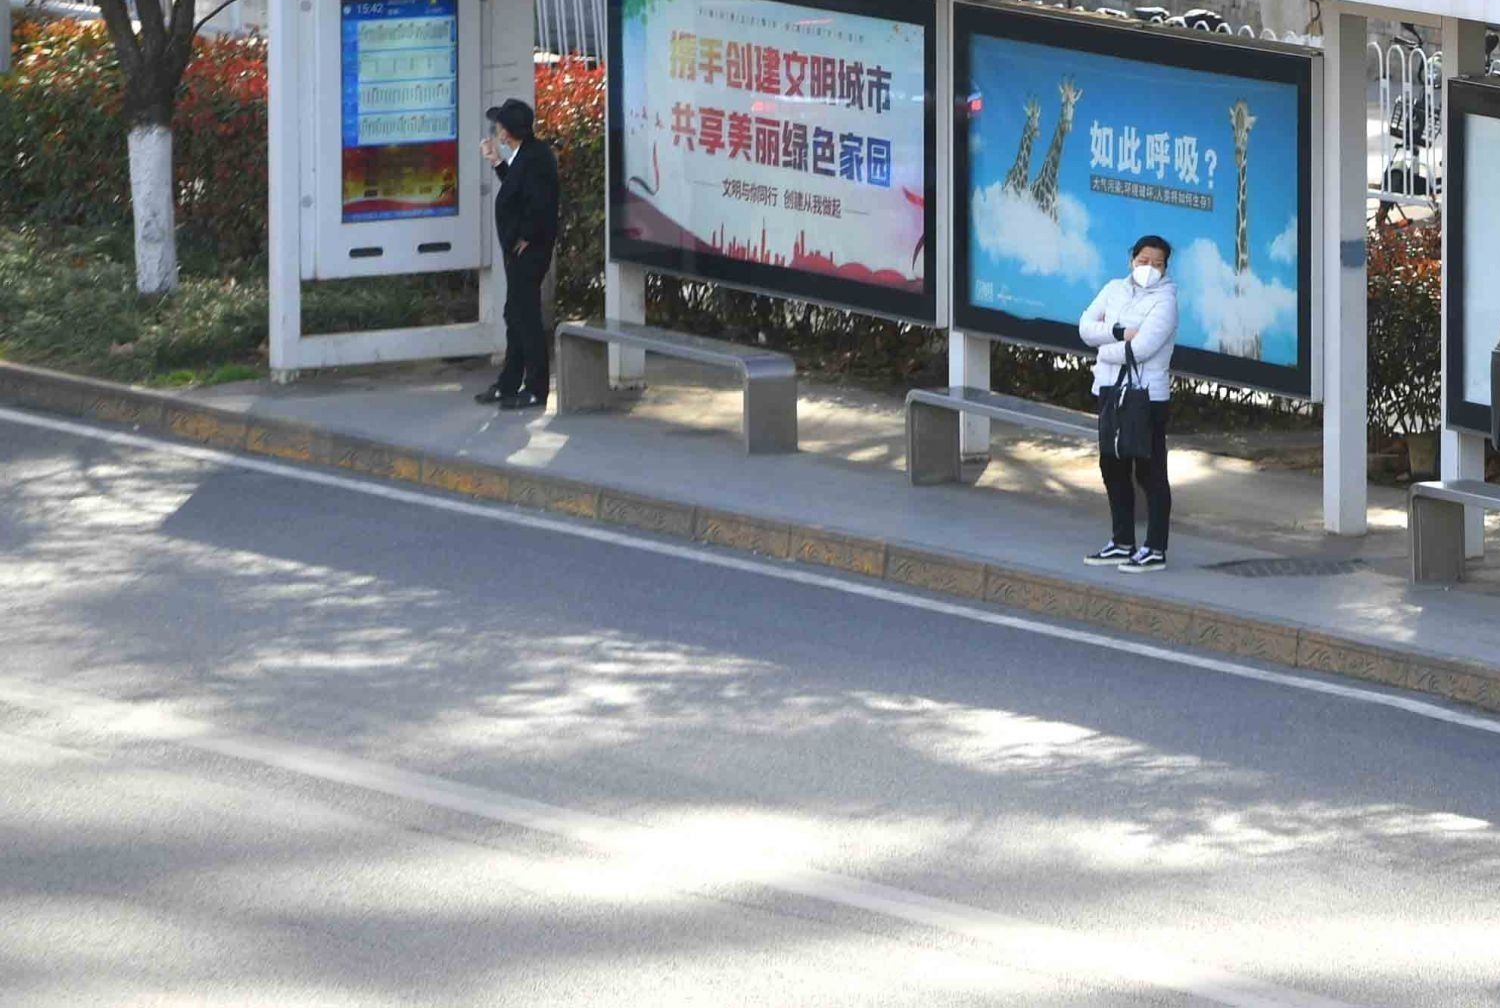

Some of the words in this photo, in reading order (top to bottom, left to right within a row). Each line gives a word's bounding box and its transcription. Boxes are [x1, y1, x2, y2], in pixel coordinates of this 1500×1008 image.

[669, 30, 892, 114] 携手创建文明城市
[671, 101, 891, 188] 共享美丽绿色家园
[783, 189, 842, 219] 创建从我做起
